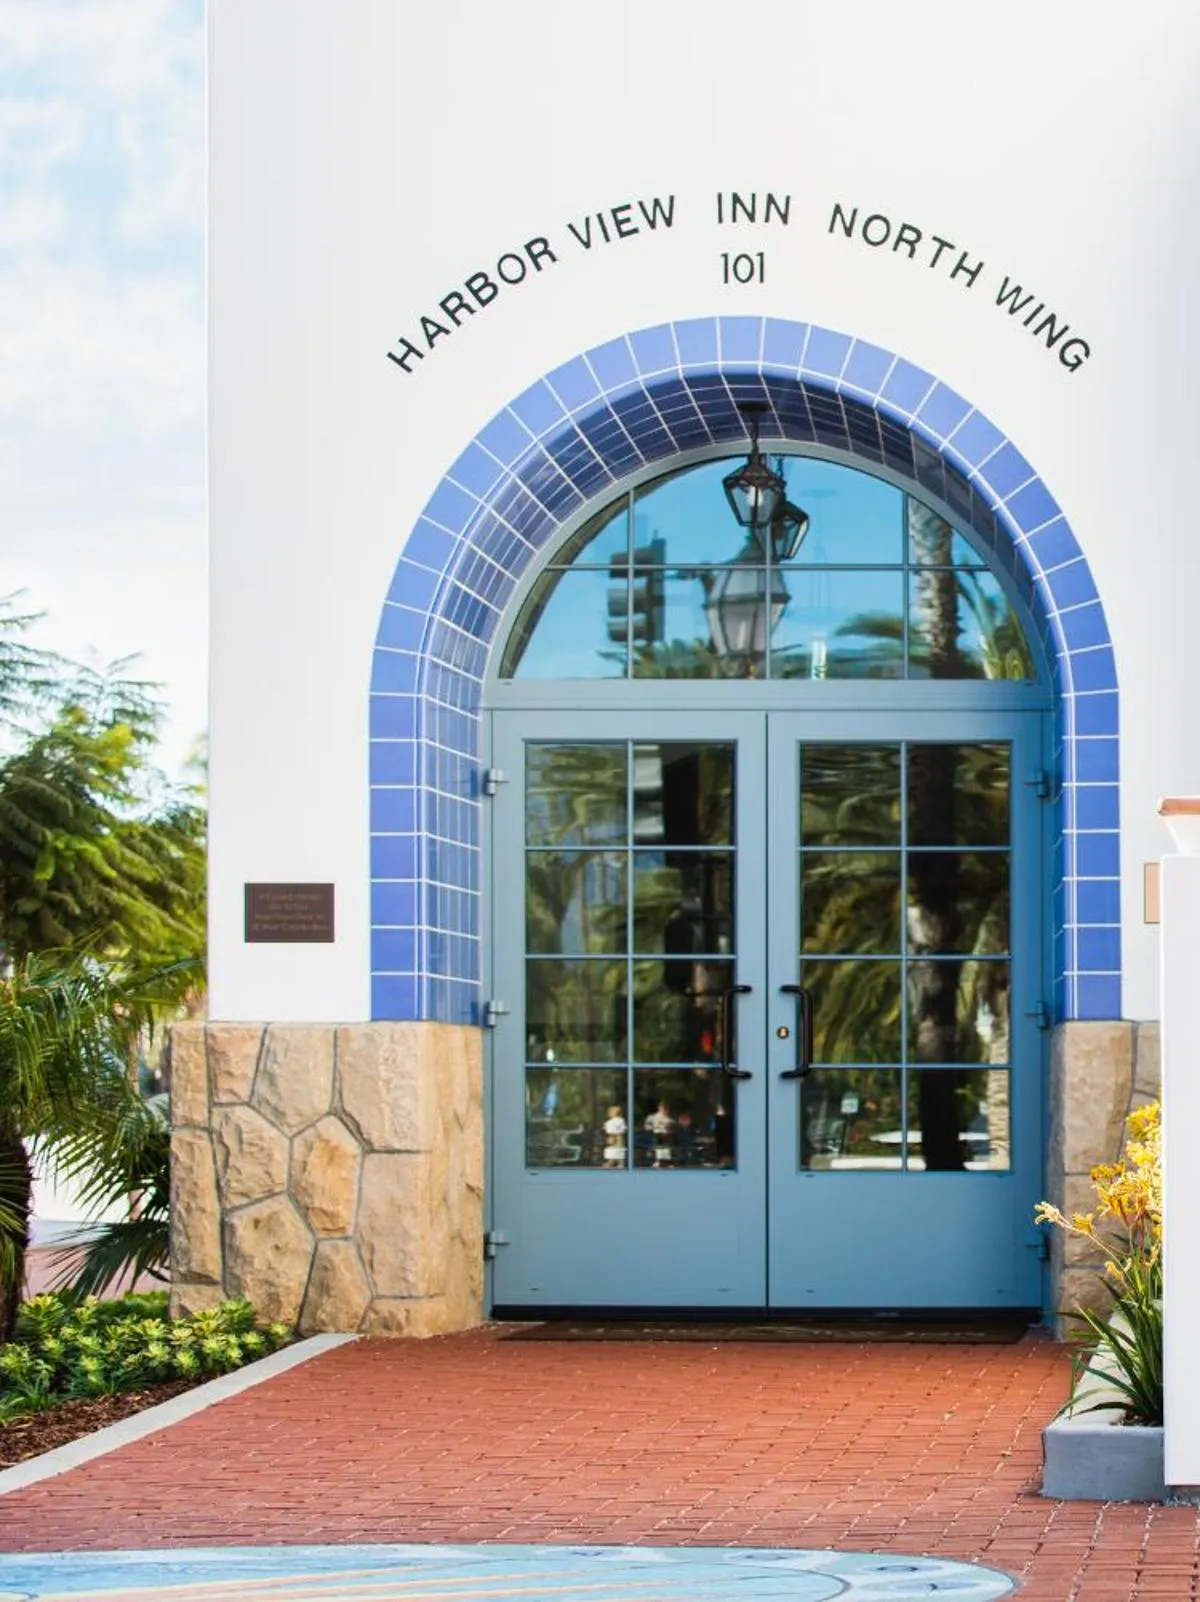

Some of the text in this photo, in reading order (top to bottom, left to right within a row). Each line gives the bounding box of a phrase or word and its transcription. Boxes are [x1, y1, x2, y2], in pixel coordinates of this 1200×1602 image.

[387, 193, 1090, 372] HARBOR VIEW INN NORTH WING
[722, 253, 764, 284] 101
